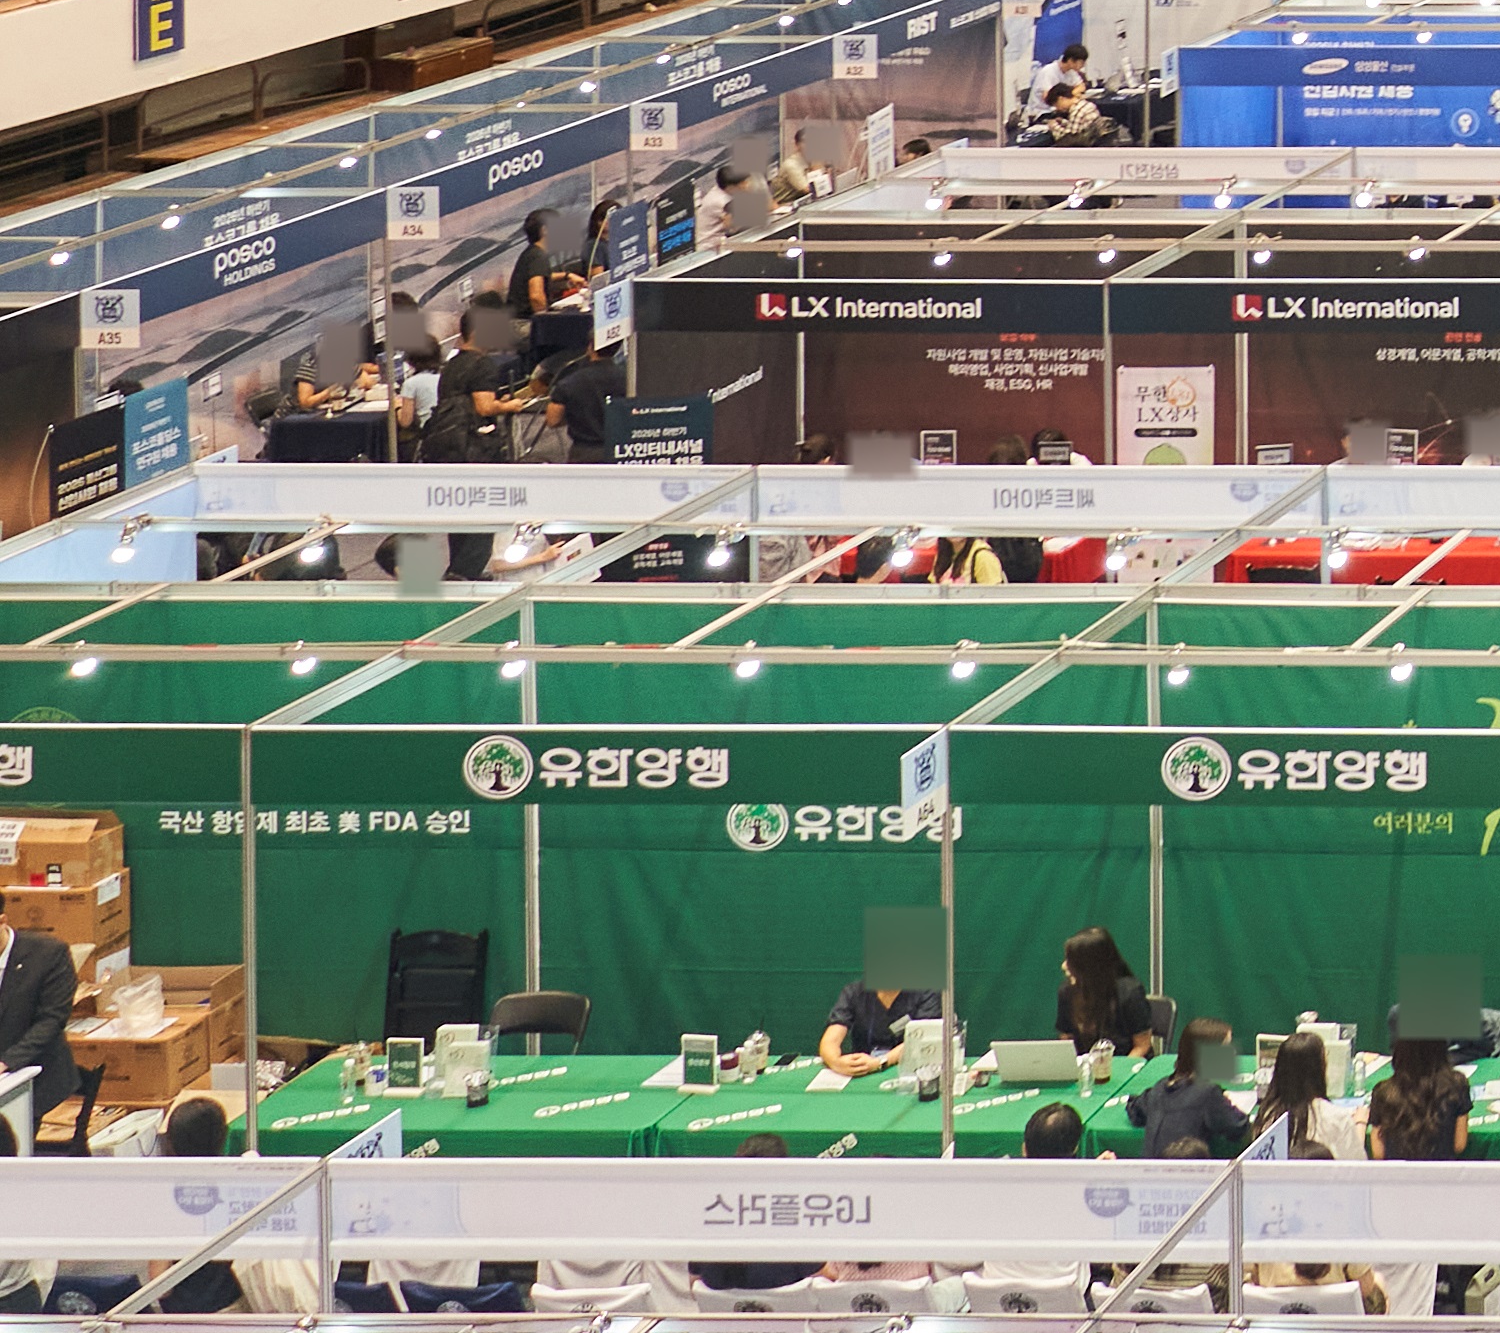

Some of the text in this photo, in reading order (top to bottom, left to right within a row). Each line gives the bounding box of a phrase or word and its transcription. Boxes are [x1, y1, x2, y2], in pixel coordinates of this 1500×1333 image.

[149, 0, 174, 52] E
[402, 225, 423, 236] A34
[213, 235, 276, 278] posco
[224, 258, 275, 287] HOLDINGS
[791, 297, 982, 319] LX International
[98, 332, 122, 346] A35
[539, 747, 728, 788] 유한양행
[159, 811, 204, 834] 국산
[285, 811, 330, 834] 최초
[339, 811, 360, 833] 美
[369, 811, 418, 831] FDA
[425, 810, 470, 834] 승인
[1373, 812, 1453, 834] 여러분의
